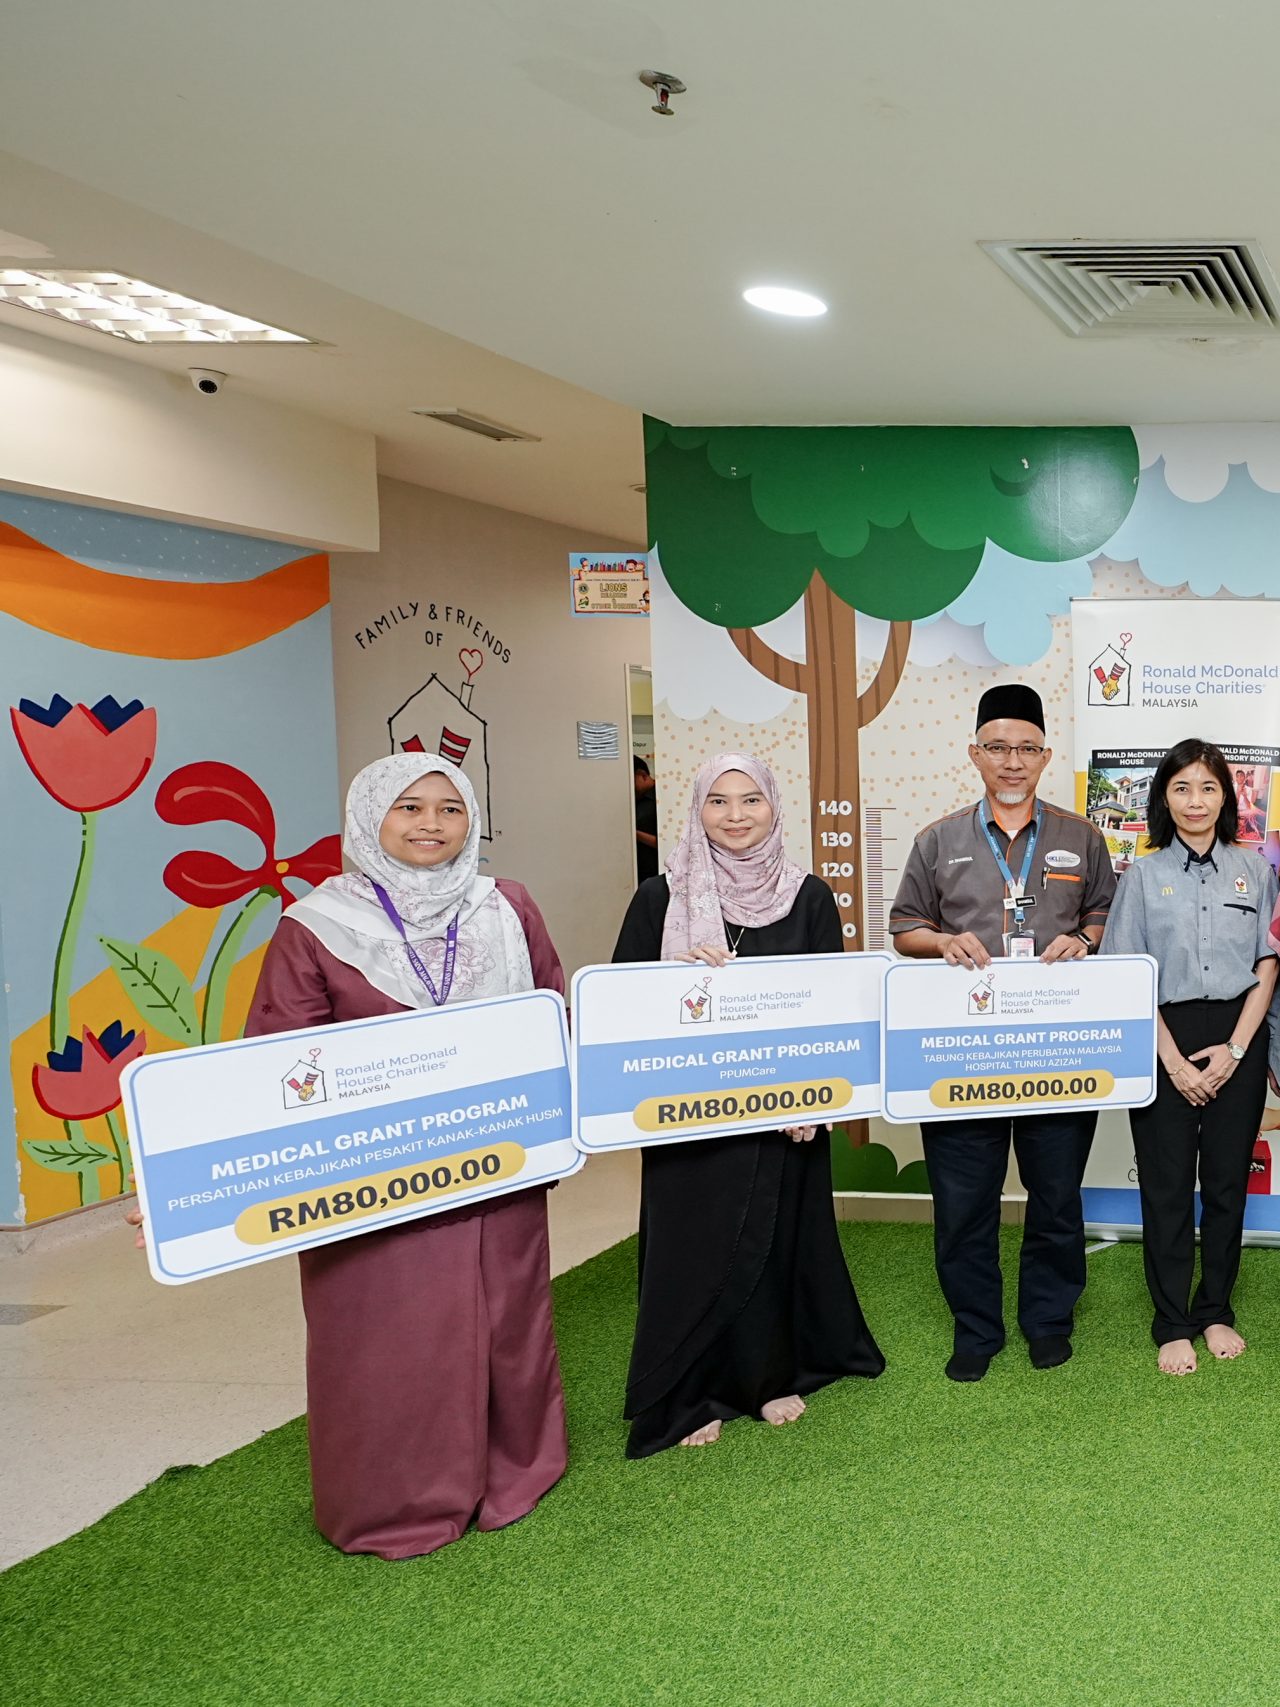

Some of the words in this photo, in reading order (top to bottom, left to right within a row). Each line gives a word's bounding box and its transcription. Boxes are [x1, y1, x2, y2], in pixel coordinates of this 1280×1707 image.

[599, 582, 628, 592] LIONS
[354, 602, 419, 649] FAMILY
[428, 603, 438, 620] &
[445, 606, 511, 663] FRIENDS
[425, 630, 443, 647] OF
[1142, 664, 1196, 678] Ronald
[1200, 664, 1278, 678] McDonald
[1142, 680, 1191, 694] House
[1195, 680, 1262, 694] Charities
[1142, 698, 1198, 708] MALAYSIA
[1223, 754, 1249, 762] NSORY
[1249, 755, 1272, 763] ROOM
[1239, 748, 1280, 757] McDONALD
[1119, 758, 1145, 766] HOUSE
[818, 800, 853, 816] 140
[820, 831, 853, 847] 130
[820, 862, 854, 878] 120
[719, 992, 757, 1003] Ronald
[759, 988, 812, 1001] McDonald
[1000, 989, 1033, 998] Ronald
[1034, 988, 1080, 997] McDonald
[719, 1004, 754, 1014] House
[755, 1000, 804, 1011] Charities
[1000, 999, 1030, 1007] House
[1031, 997, 1072, 1006] Charities
[719, 1013, 758, 1022] MALAYSIA
[921, 1034, 991, 1049] MEDICAL
[993, 1031, 1047, 1045] GRANT
[1049, 1028, 1122, 1042] PROGRAM
[334, 1059, 386, 1078] Ronald
[389, 1045, 457, 1067] McDonald
[622, 1053, 708, 1073] MEDICAL
[711, 1046, 774, 1064] GRANT
[777, 1038, 860, 1058] PROGRAM
[923, 1052, 964, 1063] TABUNG
[966, 1050, 1019, 1061] KEBAJIKAN
[1021, 1047, 1076, 1058] PERUBATAN
[1077, 1044, 1122, 1055] MALAYSIA
[965, 1061, 1012, 1071] HOSPITAL
[1013, 1059, 1046, 1068] TUNKU
[1047, 1057, 1081, 1067] AZIZAH
[336, 1074, 383, 1090] House
[385, 1060, 448, 1080] Charities
[719, 1067, 776, 1079] PPUMCare
[338, 1082, 391, 1099] MALAYSIA
[949, 1076, 1097, 1102] RM80,000.00
[658, 1086, 833, 1124] RM80,000.00
[211, 1140, 330, 1180] MEDICAL
[334, 1118, 416, 1150] GRANT
[421, 1094, 528, 1131] PROGRAM
[167, 1176, 270, 1211] PERSATUAN
[273, 1155, 361, 1186] KEBAJIKAN
[364, 1139, 423, 1163] PESAKIT
[426, 1116, 524, 1148] KANAK-KANAK
[525, 1107, 563, 1124] HUSM
[268, 1153, 501, 1233] RM80,000.00
